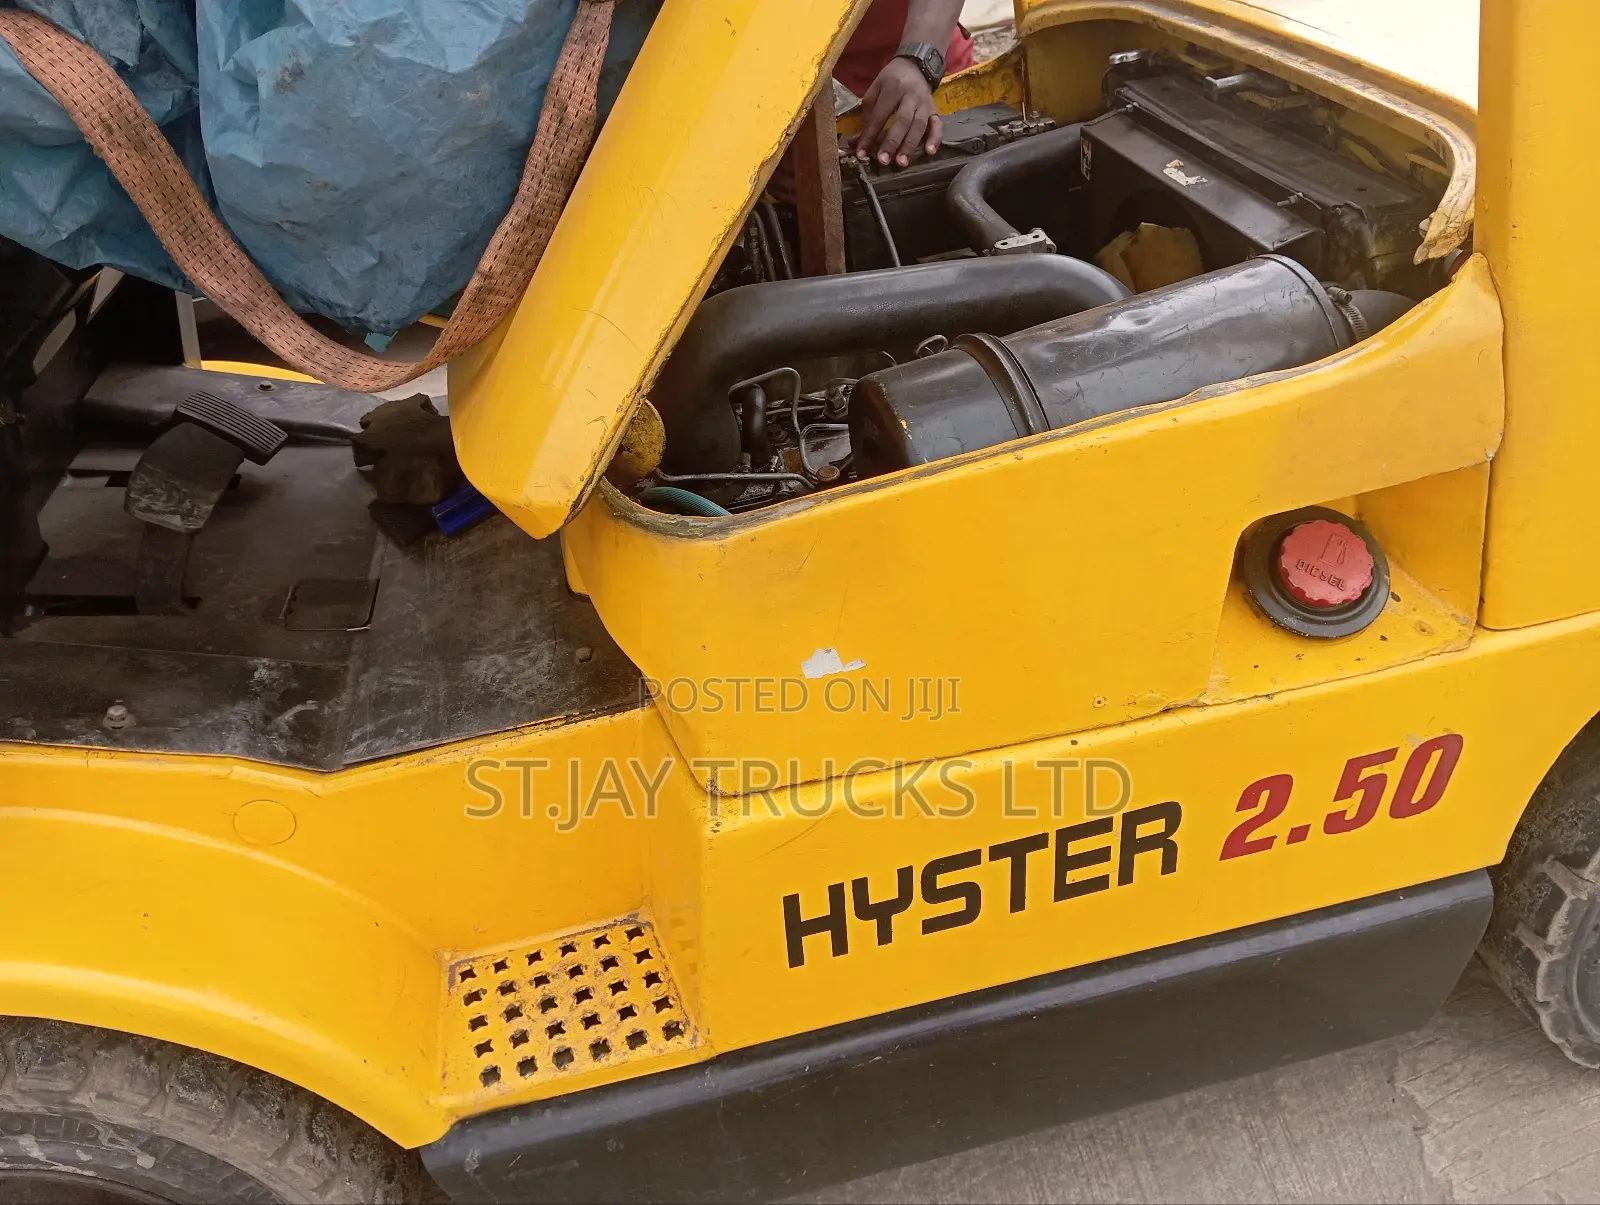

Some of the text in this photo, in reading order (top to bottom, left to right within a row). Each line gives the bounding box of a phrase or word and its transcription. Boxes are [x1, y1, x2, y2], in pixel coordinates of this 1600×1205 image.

[1295, 558, 1346, 592] DIESEL
[782, 733, 1464, 968] HYSTER 2.50
